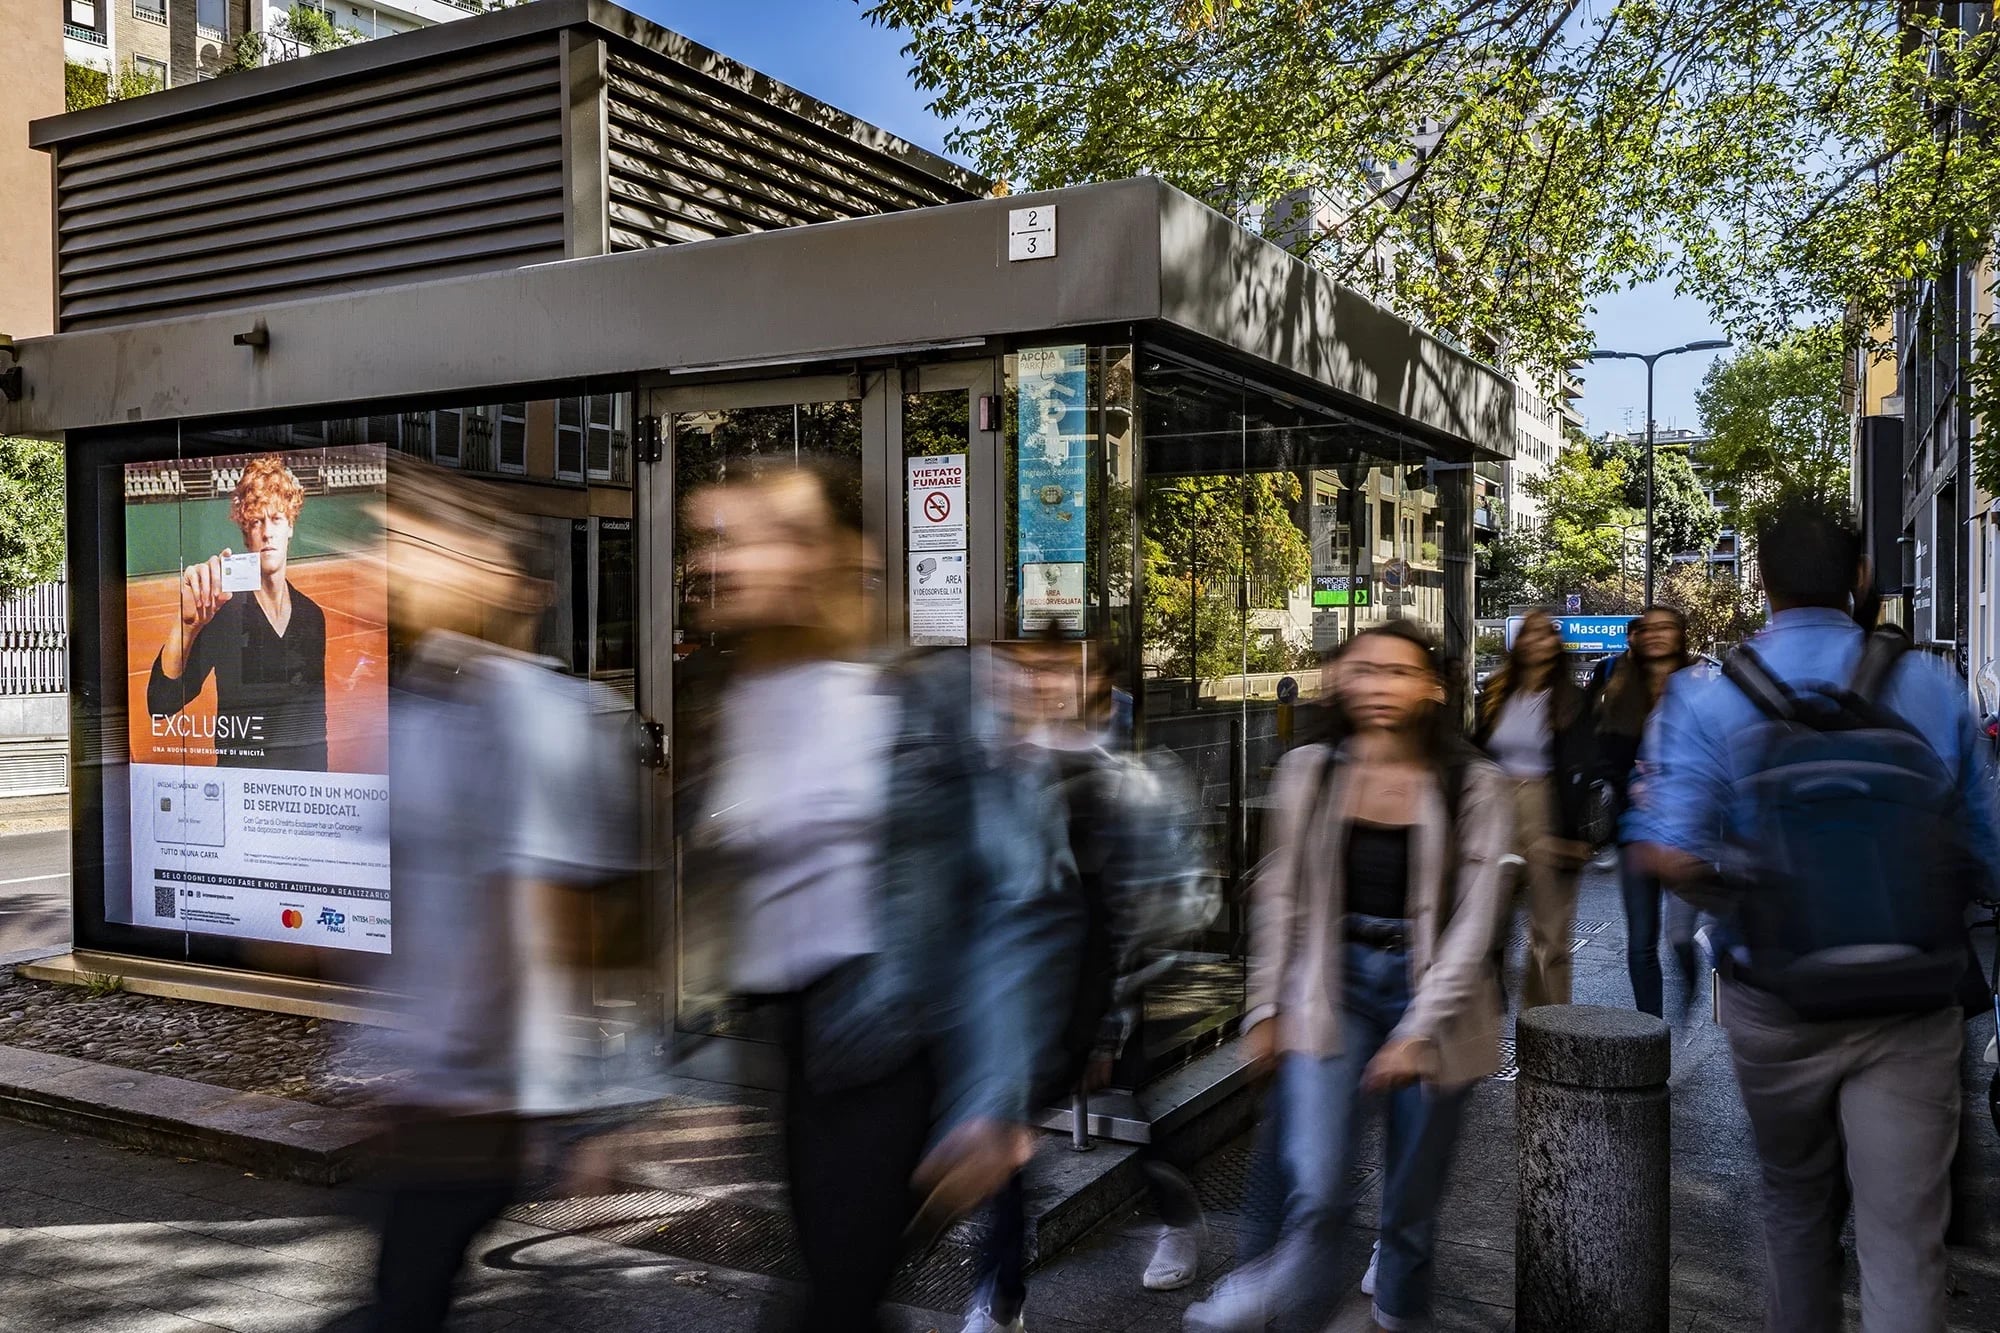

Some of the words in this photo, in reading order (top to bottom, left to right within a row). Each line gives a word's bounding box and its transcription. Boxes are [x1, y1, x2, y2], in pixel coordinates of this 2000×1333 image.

[1028, 210, 1038, 227] 2
[1027, 237, 1037, 254] 3
[1020, 351, 1056, 362] APCOA
[1020, 360, 1056, 371] PARKING
[912, 467, 962, 478] VIETATO
[913, 476, 962, 487] FUMARE
[945, 574, 962, 584] AREA
[1316, 577, 1363, 585] PARCHEIO
[913, 587, 962, 596] VIDEOSORVEGLIATA
[1045, 589, 1061, 597] AREA
[1569, 622, 1629, 636] Mascagni
[151, 713, 265, 740] EXCLUSIVE
[189, 747, 228, 756] DIMENSIONE
[239, 748, 265, 757] UNICITÀ
[243, 782, 307, 797] BENVENUTO
[310, 785, 322, 798] IN
[325, 787, 341, 799] UN
[344, 788, 388, 801] MONDO
[243, 799, 255, 811] DI
[258, 800, 301, 814] SERVIZI
[304, 802, 360, 817] DEDICATI.
[160, 848, 178, 856] TUTTO
[186, 849, 199, 857] UNA
[200, 850, 219, 859] CARTA
[161, 871, 170, 879] SE
[172, 872, 181, 880] LO
[207, 875, 216, 883] LO
[218, 876, 236, 885] PUOI
[238, 877, 255, 887] FARE
[264, 881, 278, 889] NOI
[280, 882, 288, 890] TI
[290, 883, 328, 894] AIUTIAMO
[338, 887, 390, 900] REALIZZARLO
[326, 925, 346, 934] FINALS
